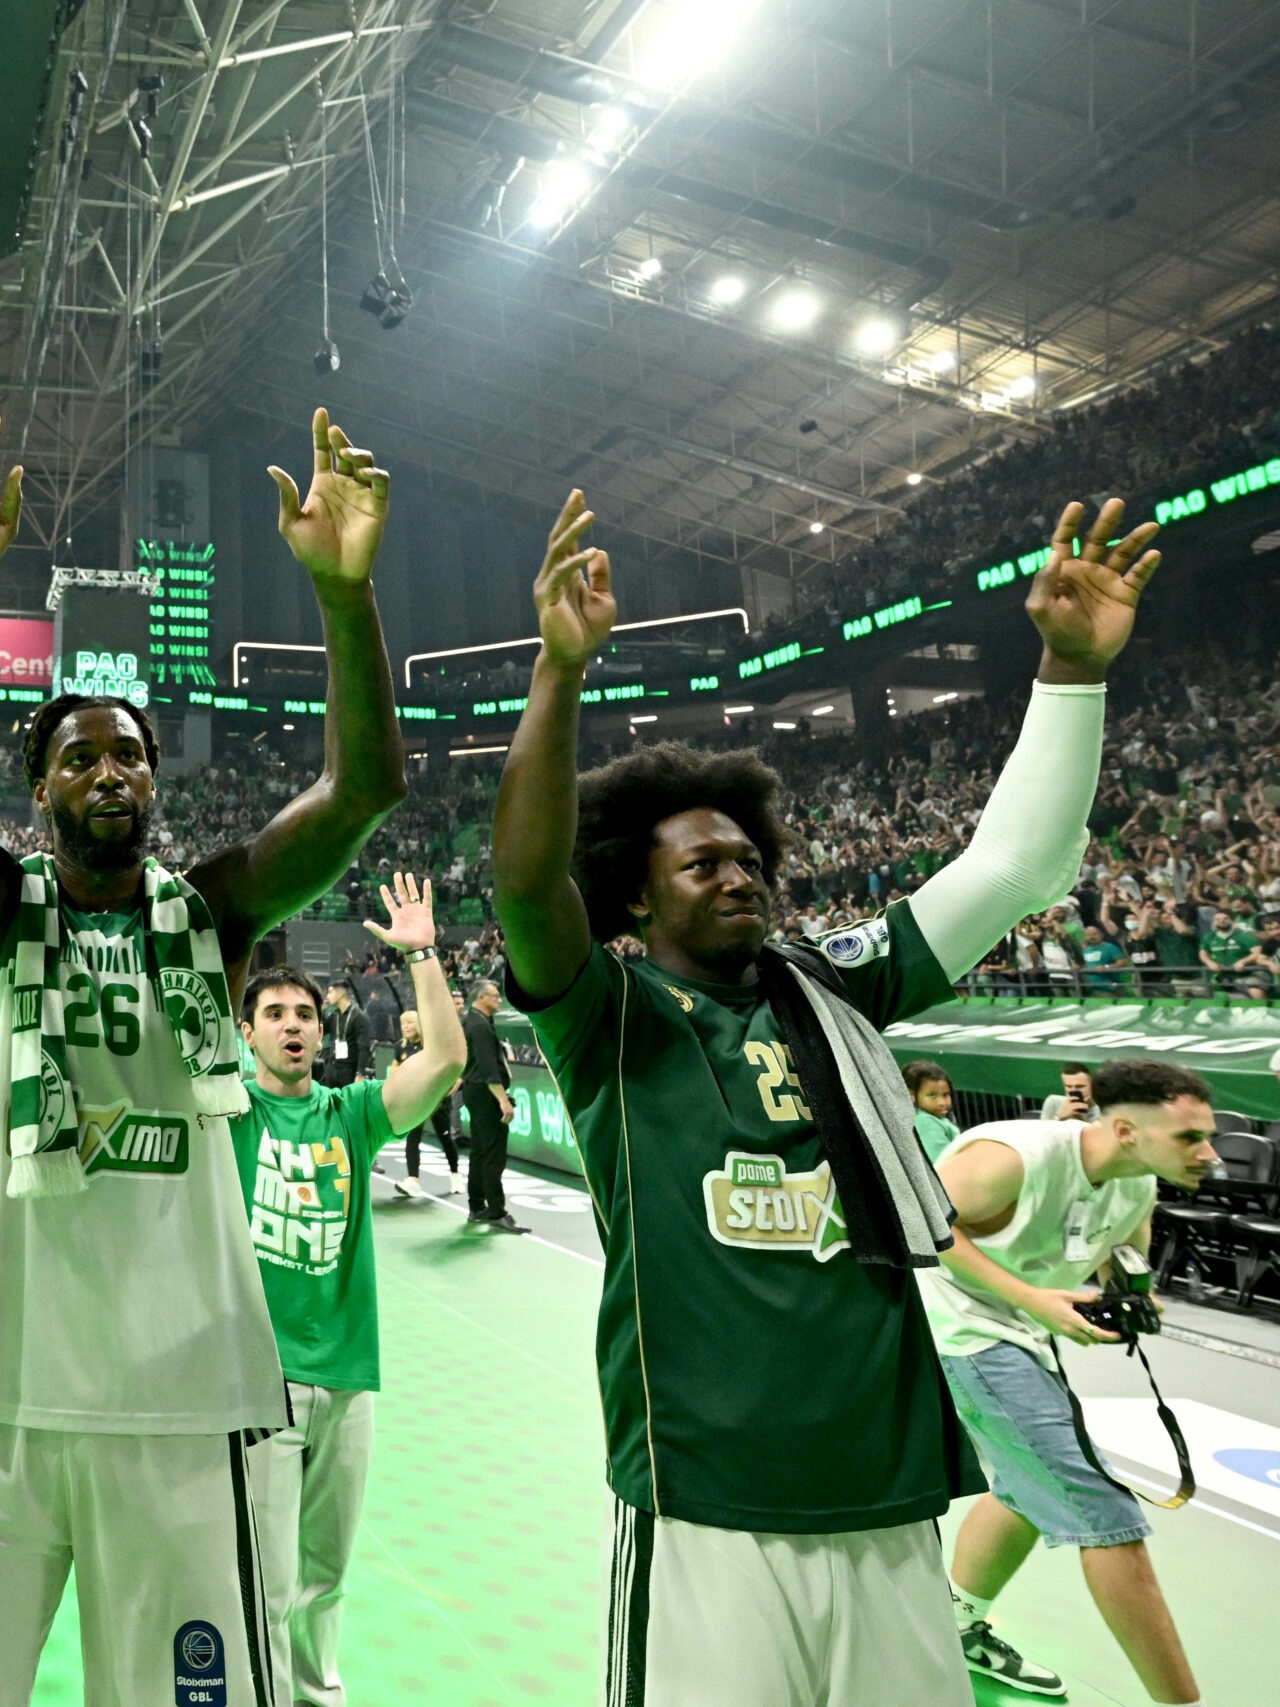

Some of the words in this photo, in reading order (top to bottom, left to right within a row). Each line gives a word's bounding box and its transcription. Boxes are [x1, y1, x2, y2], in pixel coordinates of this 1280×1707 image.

[1156, 489, 1206, 525] PAO
[1210, 458, 1280, 503] WINS
[169, 569, 209, 582] WINS!
[977, 561, 1015, 591] PAO
[169, 588, 209, 600] WINS!
[149, 604, 165, 617] AO
[169, 605, 209, 620] WINS!
[843, 615, 872, 641] PAO
[874, 596, 922, 629] WINS!
[149, 624, 165, 636] AO
[169, 625, 209, 638] WINS!
[149, 643, 165, 655] AO
[169, 644, 209, 658] WINS!
[76, 651, 137, 681] PAO
[739, 657, 762, 679] PAO
[763, 642, 801, 670] WINS!
[690, 676, 719, 691] PAO
[9, 689, 44, 703] WINS!
[63, 677, 149, 708] WINS
[604, 684, 645, 701] WINS!
[189, 691, 213, 704] PAO
[214, 696, 248, 710] WINS!
[284, 700, 307, 713] PAO
[403, 706, 437, 719] WINS!
[473, 702, 497, 716] PAO
[64, 973, 140, 1056] 26
[737, 1163, 776, 1183] pame
[176, 1675, 224, 1687] Stoiximan
[189, 1691, 213, 1702] GBL
